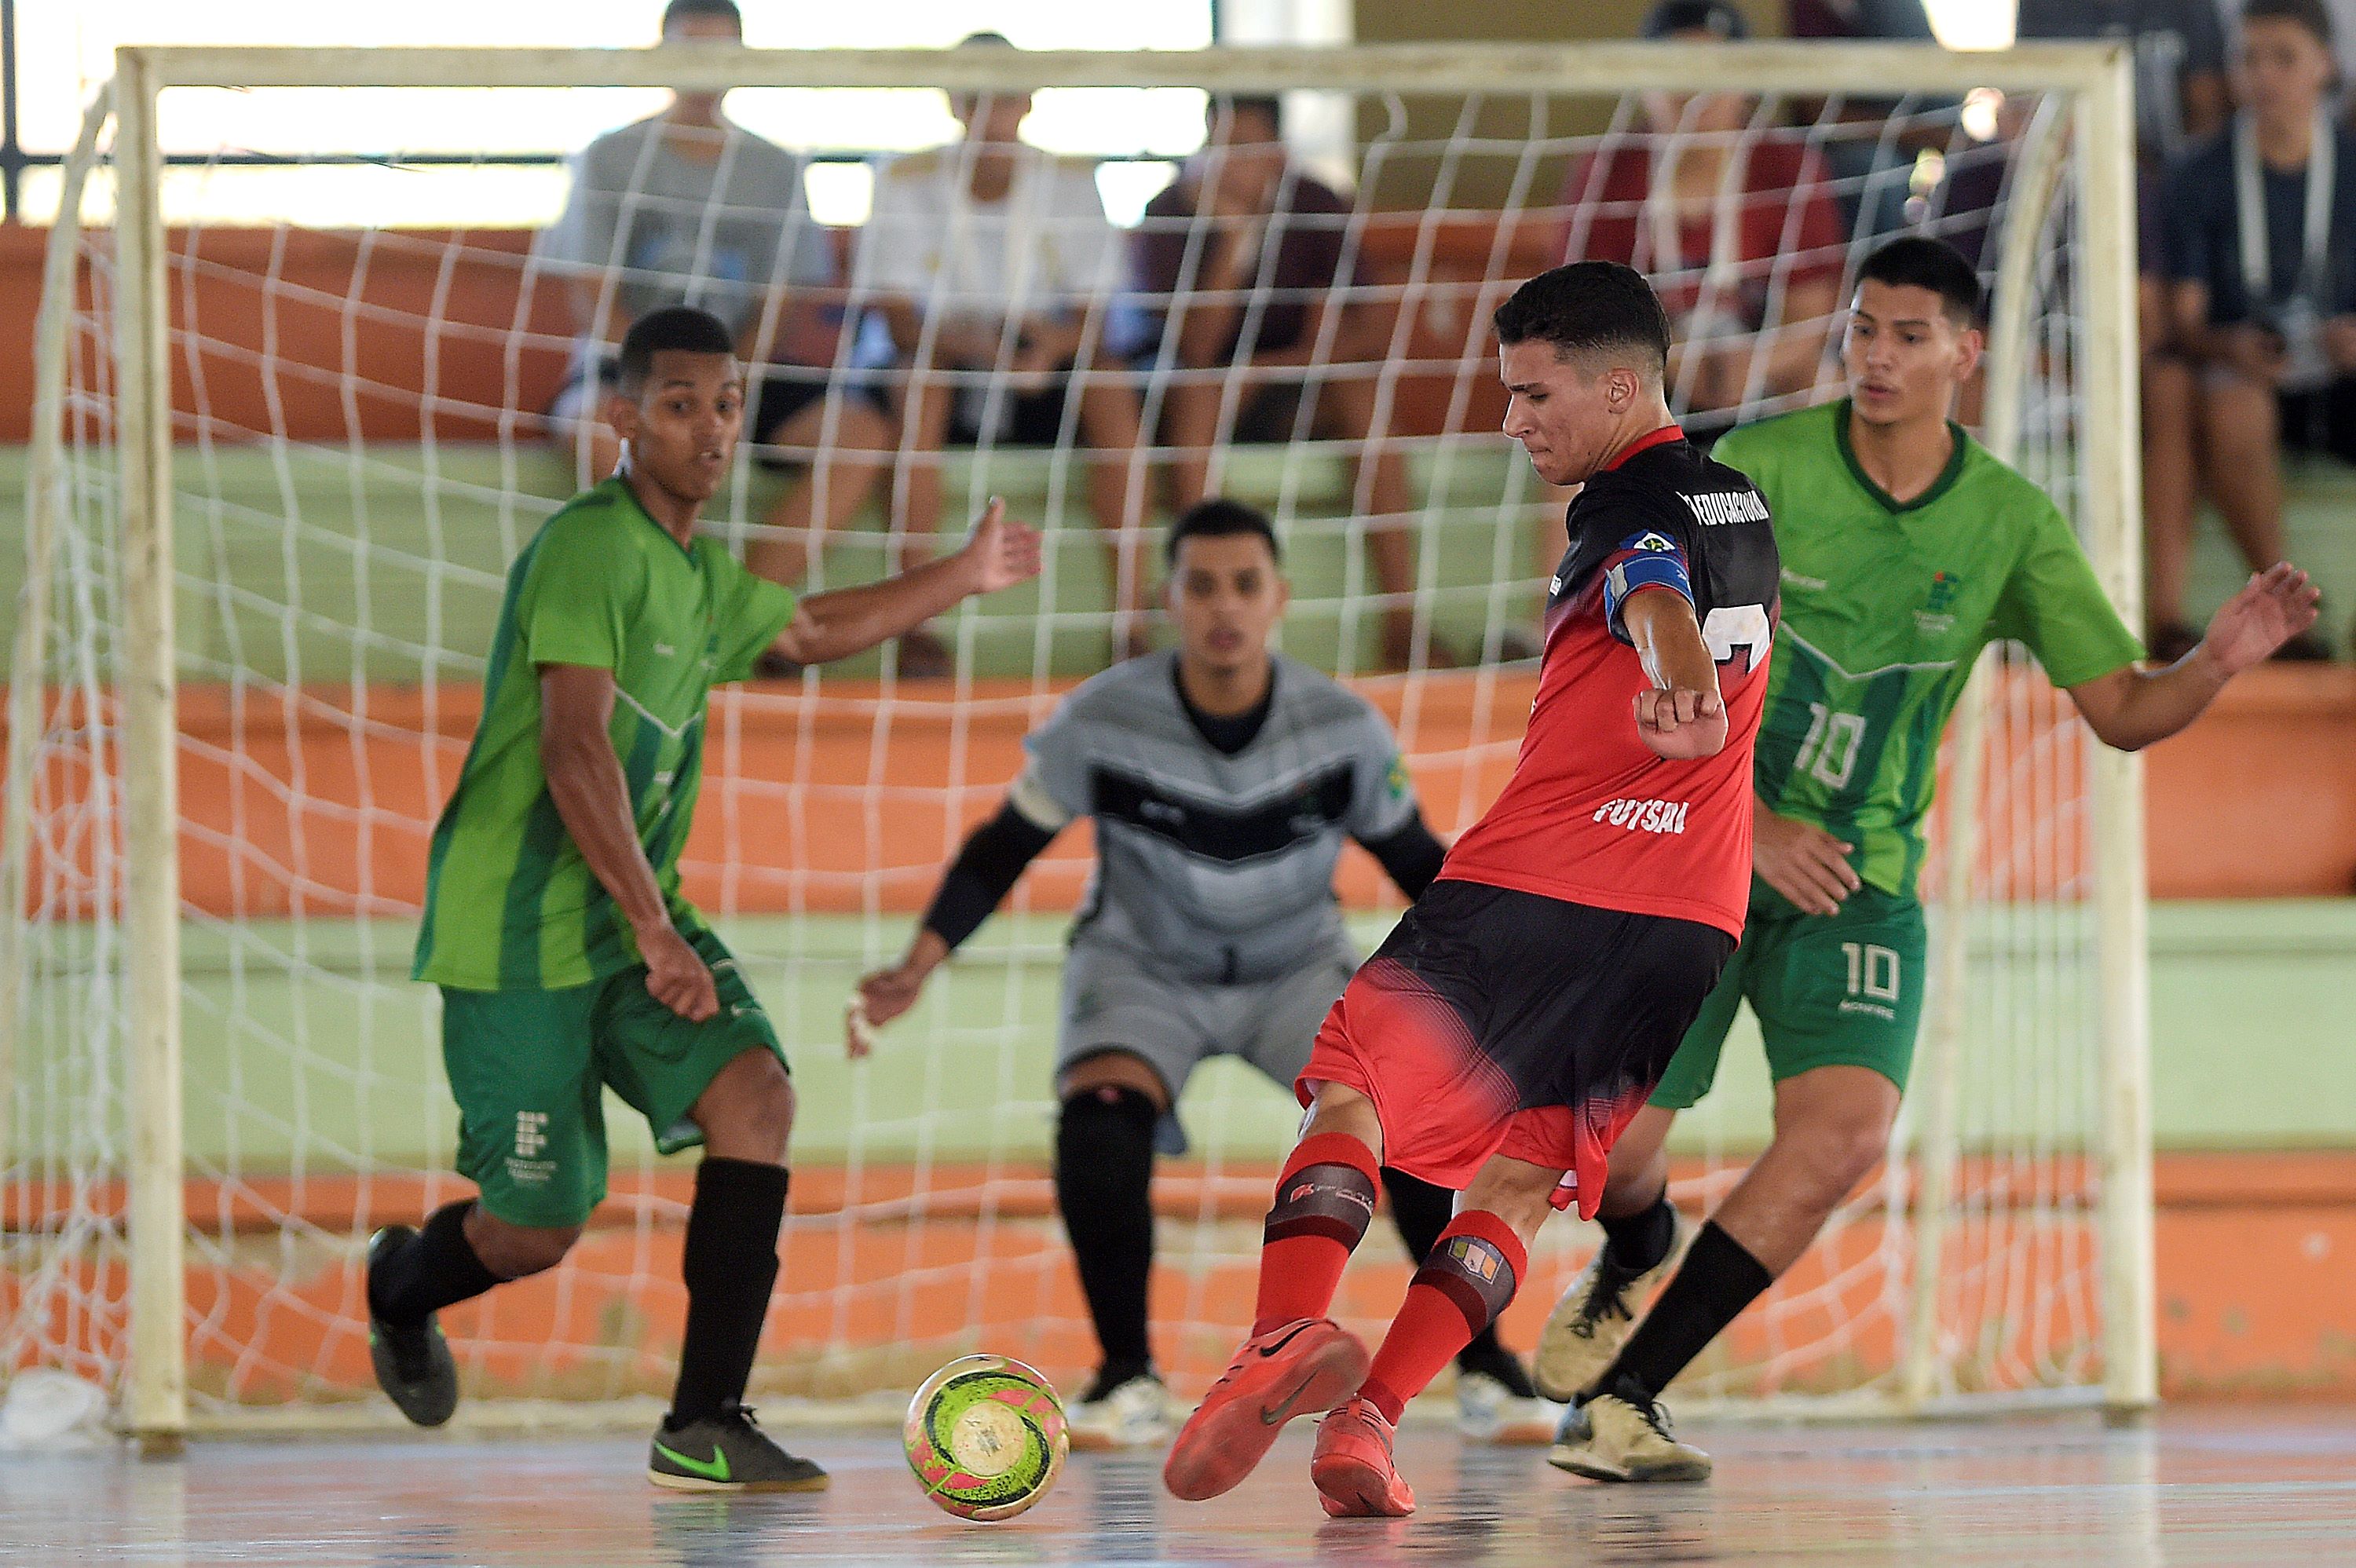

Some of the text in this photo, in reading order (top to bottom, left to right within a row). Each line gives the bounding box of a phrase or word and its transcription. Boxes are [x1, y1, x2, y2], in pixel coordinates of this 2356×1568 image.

[1793, 701, 1865, 789] 10
[1593, 798, 1689, 834] FUTSAL
[1841, 942, 1901, 1001] 10
